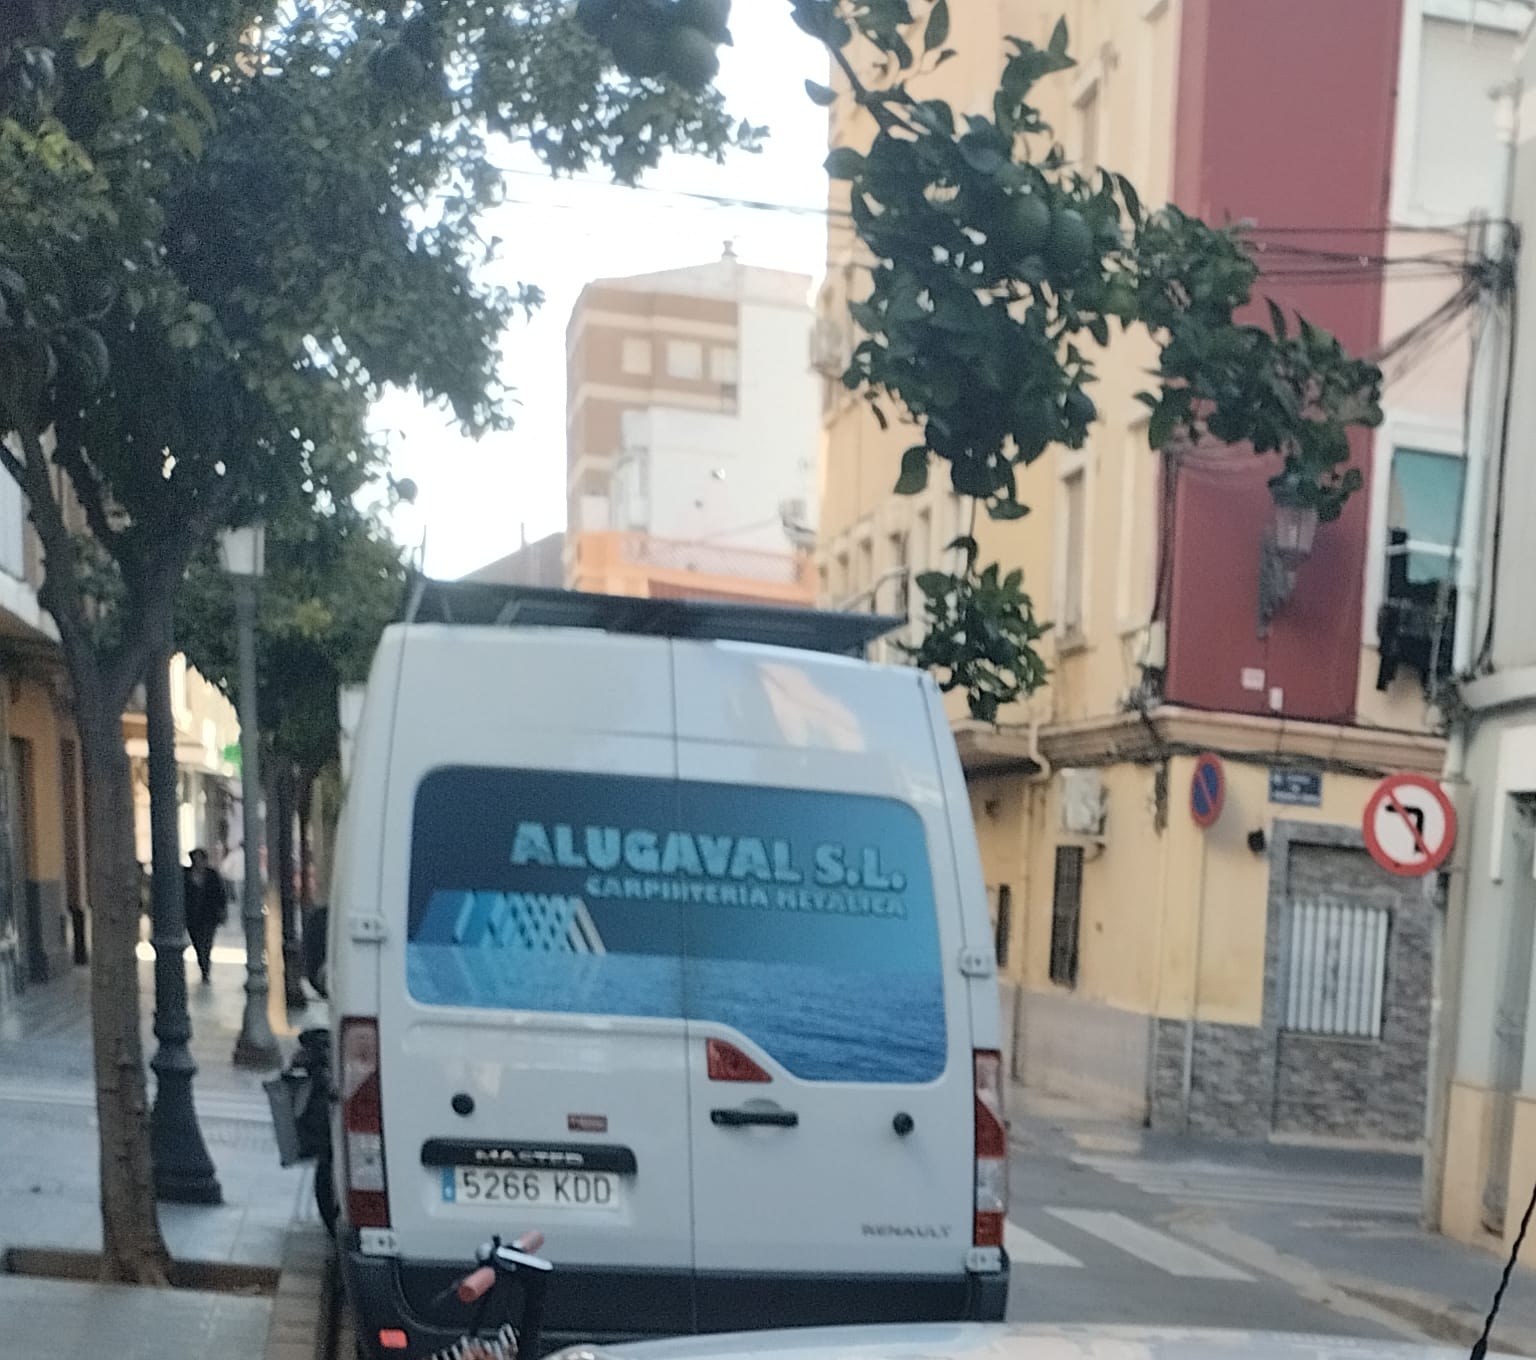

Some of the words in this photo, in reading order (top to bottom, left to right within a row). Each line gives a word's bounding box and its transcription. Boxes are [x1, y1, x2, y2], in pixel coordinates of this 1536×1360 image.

[510, 820, 802, 883] ALUGAVAL
[814, 842, 908, 892] S.L.
[463, 1171, 541, 1201] 5266
[554, 1174, 612, 1204] KDD
